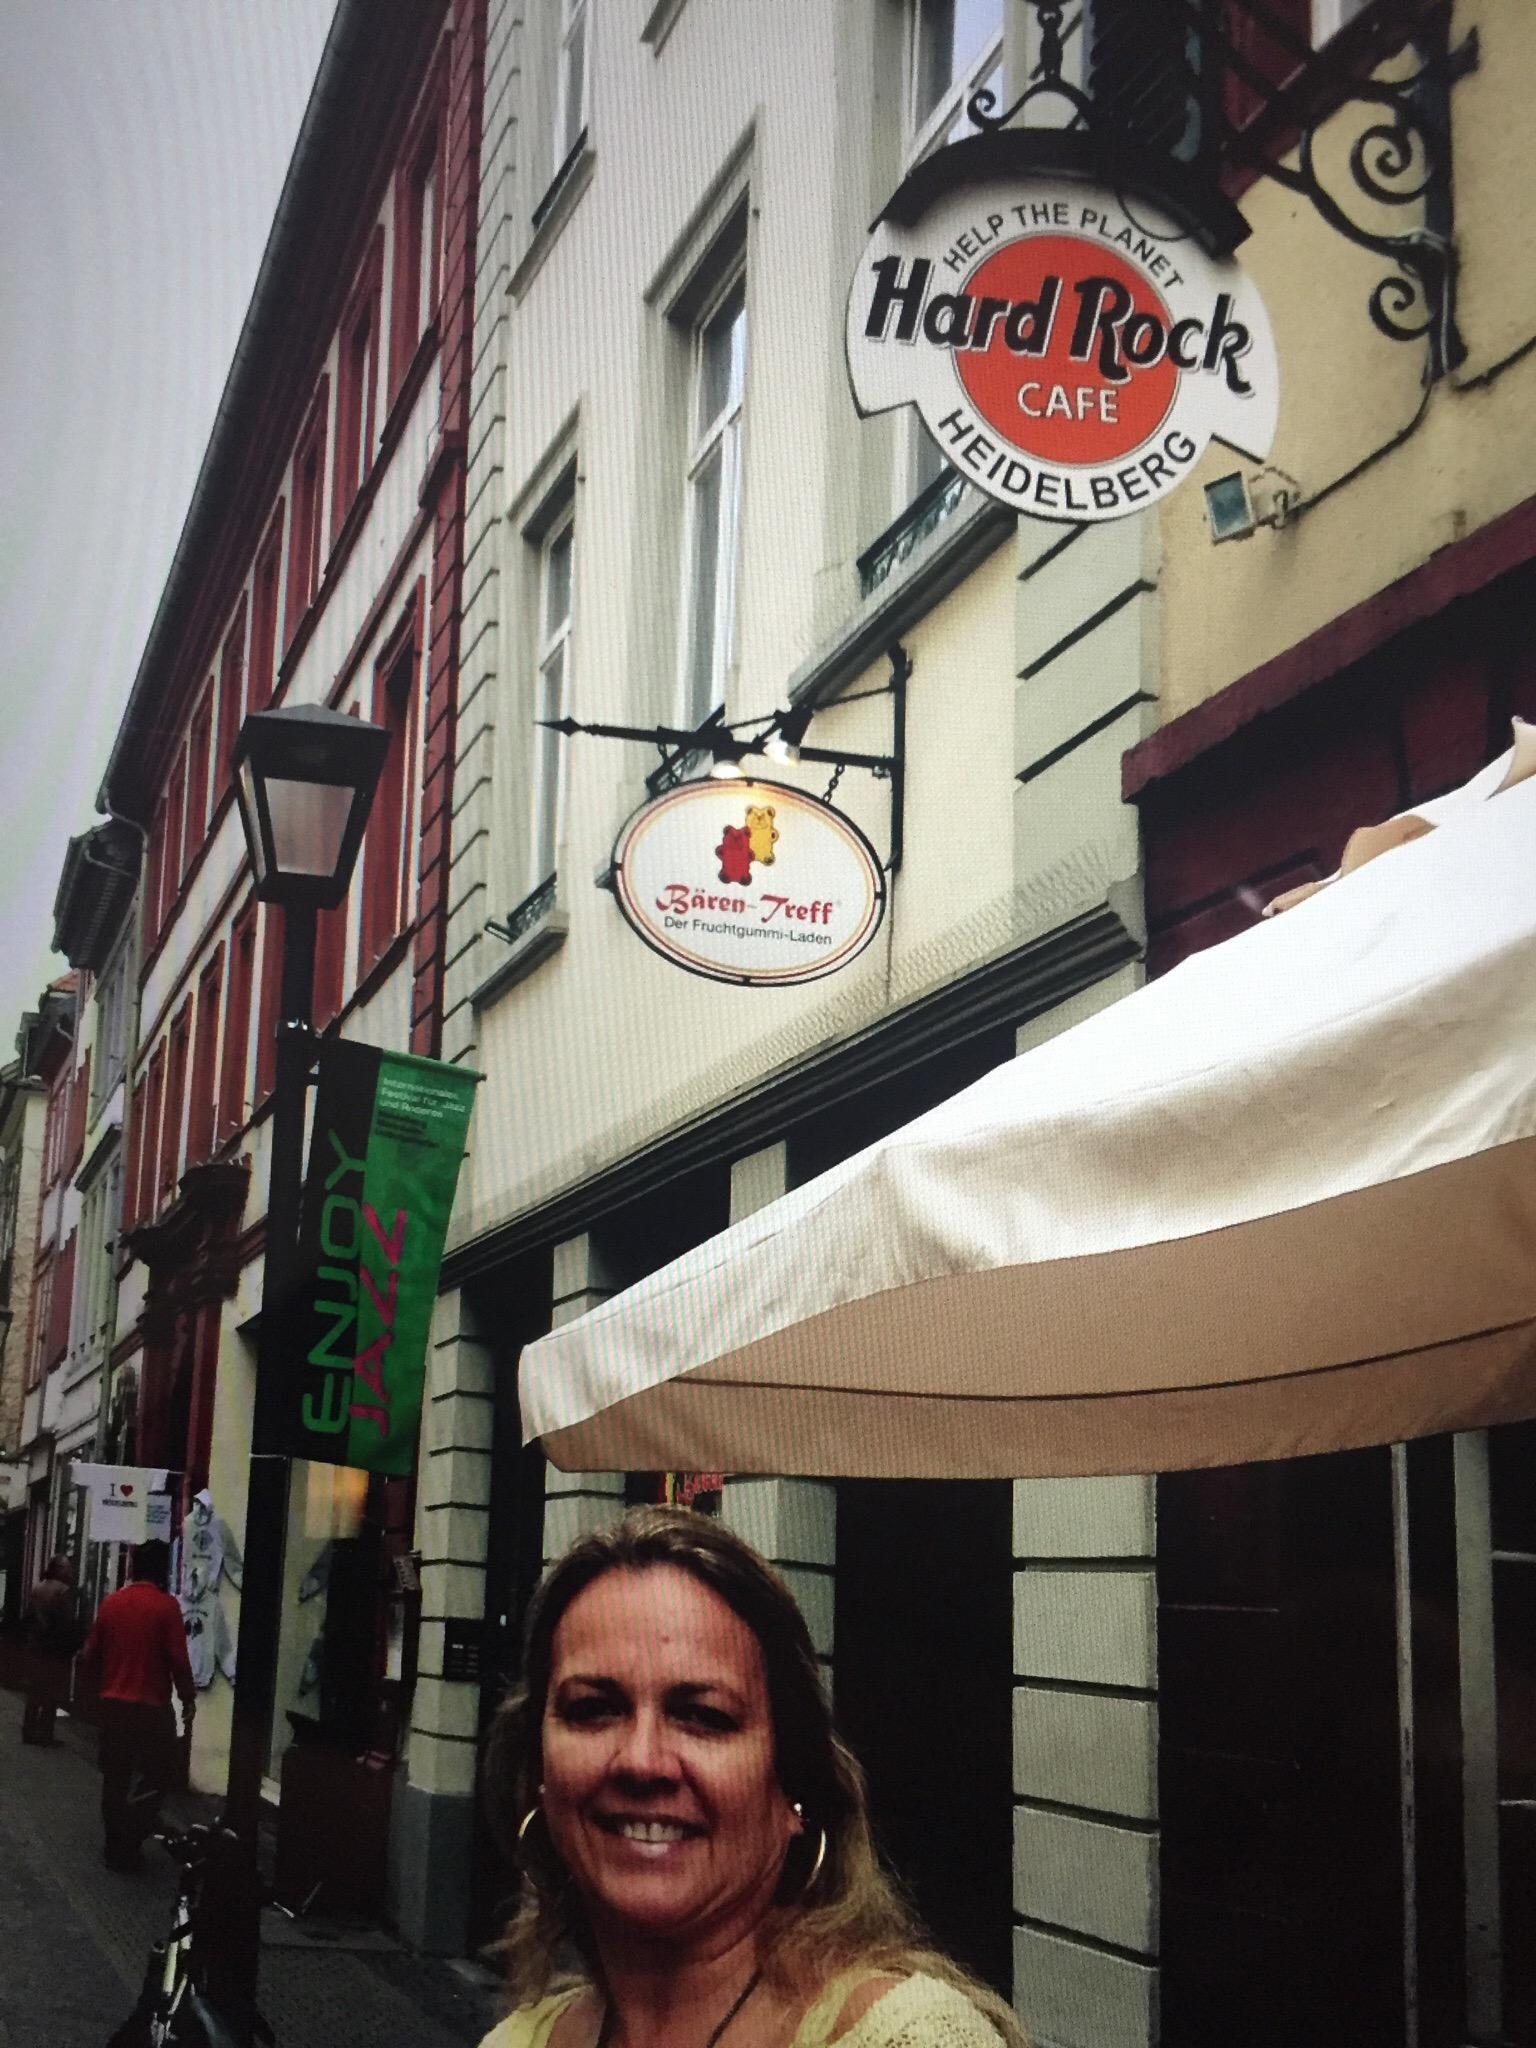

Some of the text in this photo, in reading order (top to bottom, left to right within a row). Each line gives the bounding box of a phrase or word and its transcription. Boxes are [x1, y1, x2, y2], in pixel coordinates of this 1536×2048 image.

[942, 203, 1184, 290] HELP THE PLANET
[865, 255, 1254, 398] Hard Rock
[1017, 382, 1120, 424] CAFE
[938, 408, 1197, 511] HEIDELBERG
[655, 884, 834, 926] Bären-Treff
[664, 915, 833, 946] Der Fruchtgummi-Laden
[302, 1128, 368, 1435] ENJOY
[349, 1202, 408, 1439] JAZZ
